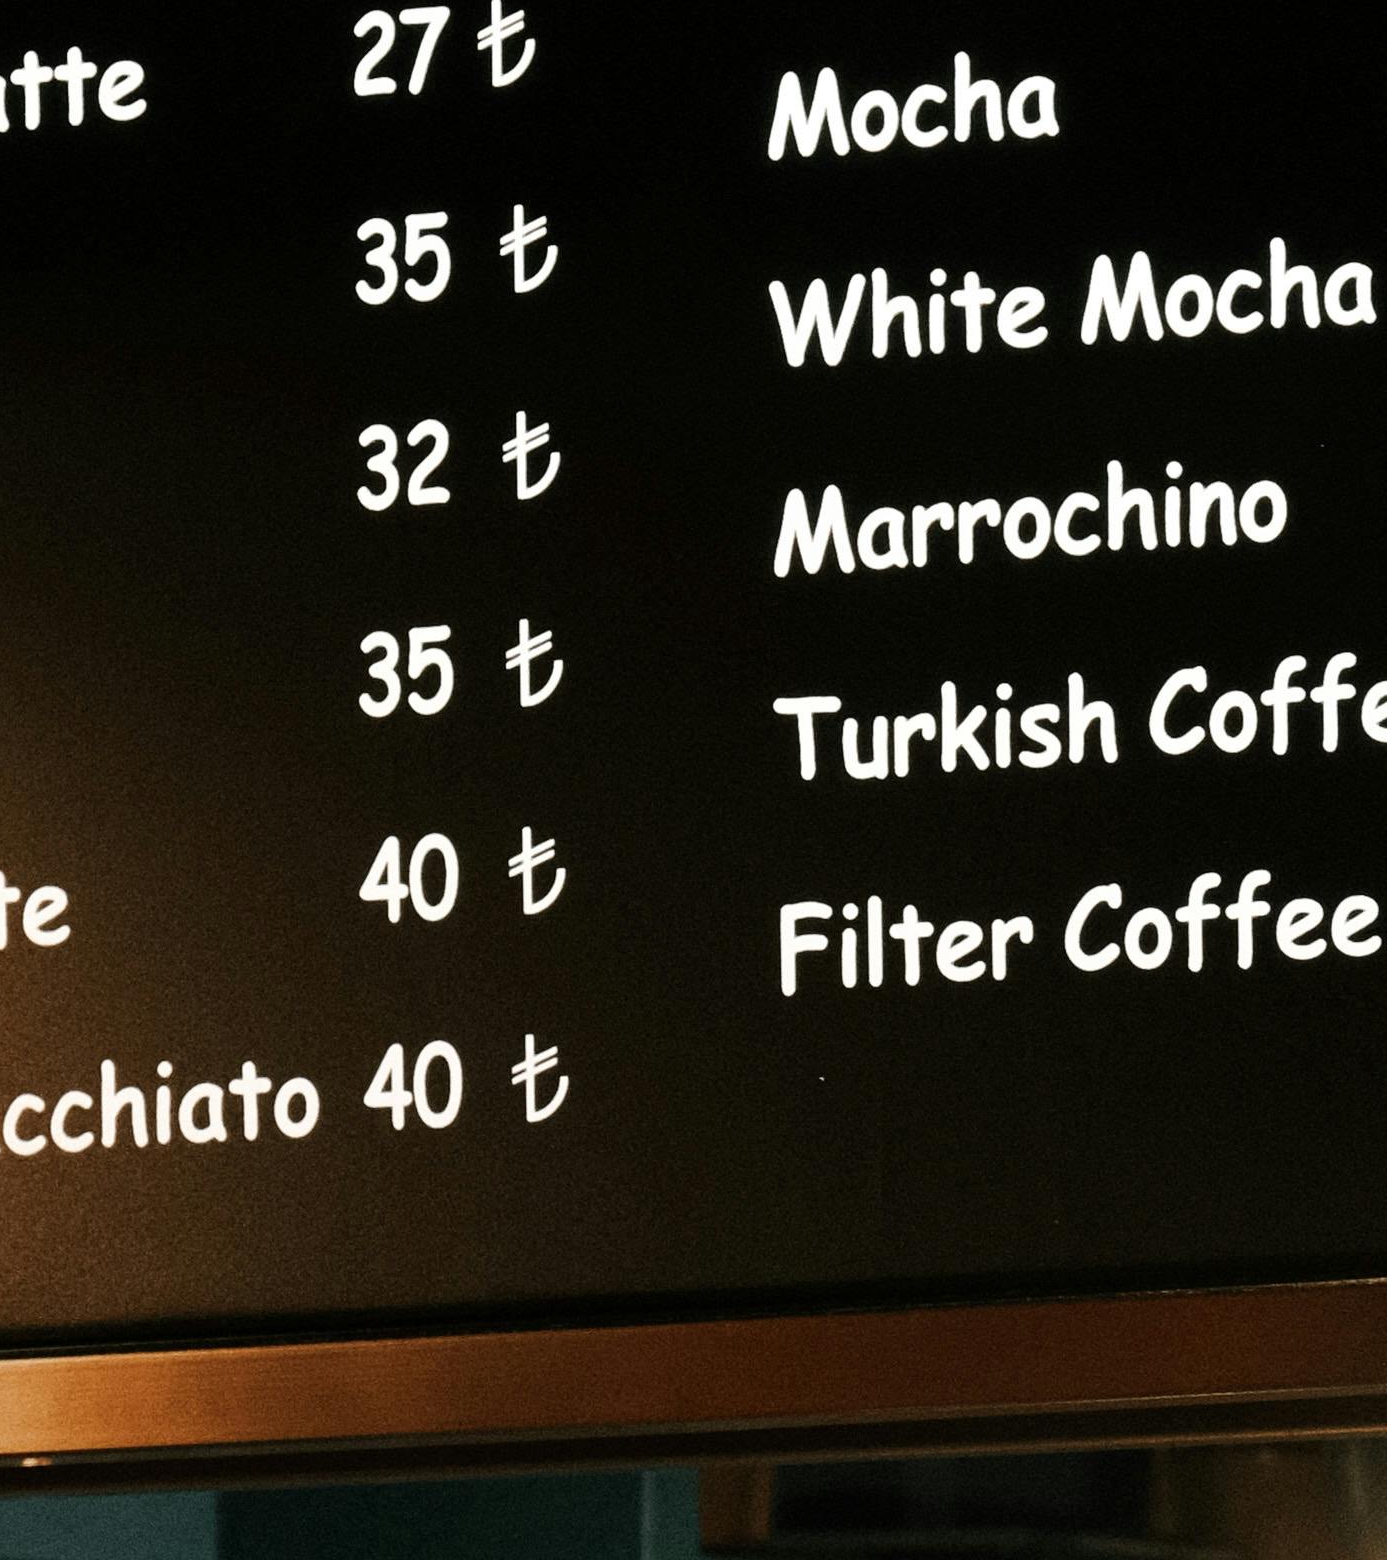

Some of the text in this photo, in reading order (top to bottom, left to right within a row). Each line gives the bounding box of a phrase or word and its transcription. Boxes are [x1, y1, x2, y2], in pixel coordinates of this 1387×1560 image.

[352, 4, 452, 98] 27
[766, 49, 1061, 163] Mocha
[354, 210, 453, 307] 35
[767, 235, 1379, 369] White Mocha
[355, 417, 452, 513] 32
[772, 458, 1289, 579] Marrochino
[357, 623, 456, 719] 35
[771, 670, 1120, 782] Turkish
[357, 831, 461, 925] 40
[778, 868, 1384, 998] Filter Coffee
[362, 1038, 465, 1132] 40
